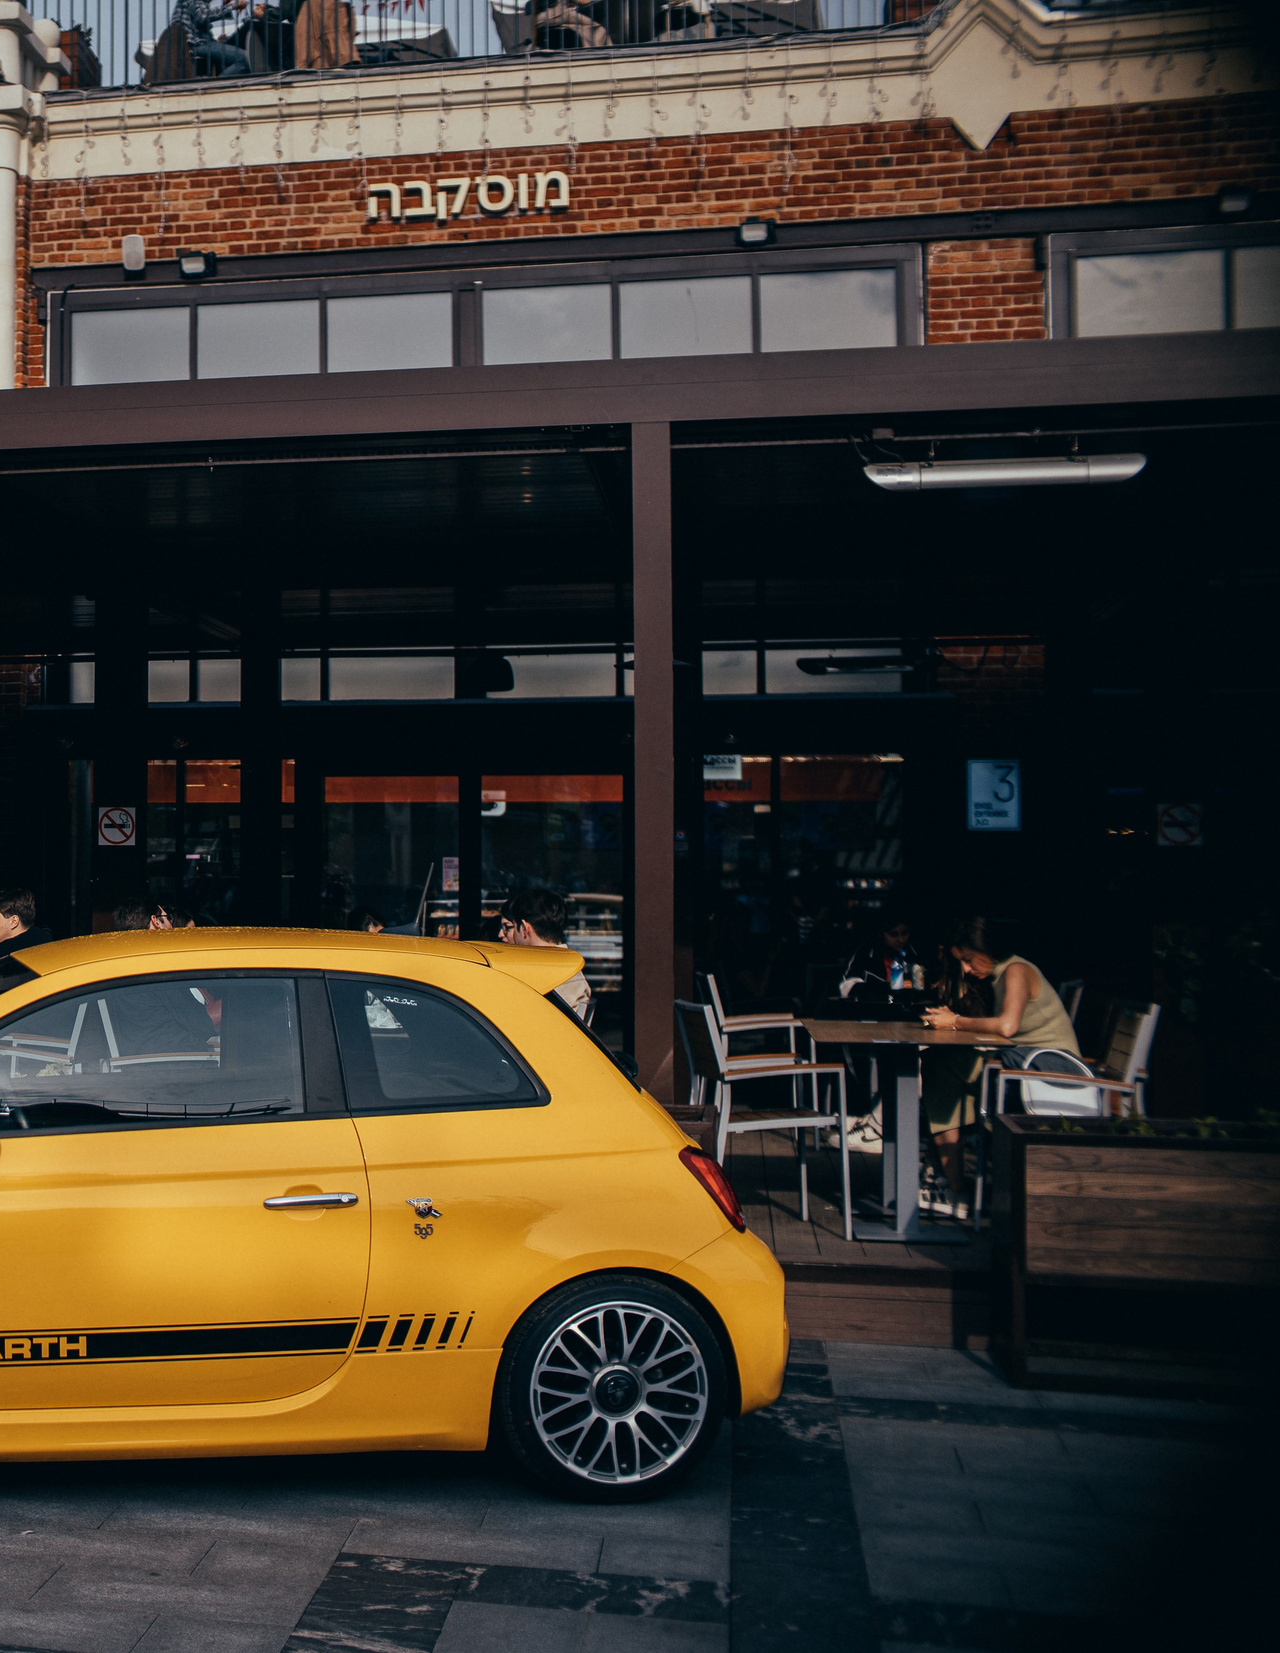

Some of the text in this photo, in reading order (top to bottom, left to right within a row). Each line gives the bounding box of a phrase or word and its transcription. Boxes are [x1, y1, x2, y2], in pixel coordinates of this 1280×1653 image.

[367, 169, 570, 222] מוסקבה
[993, 764, 1015, 803] 3
[414, 1223, 433, 1239] 595
